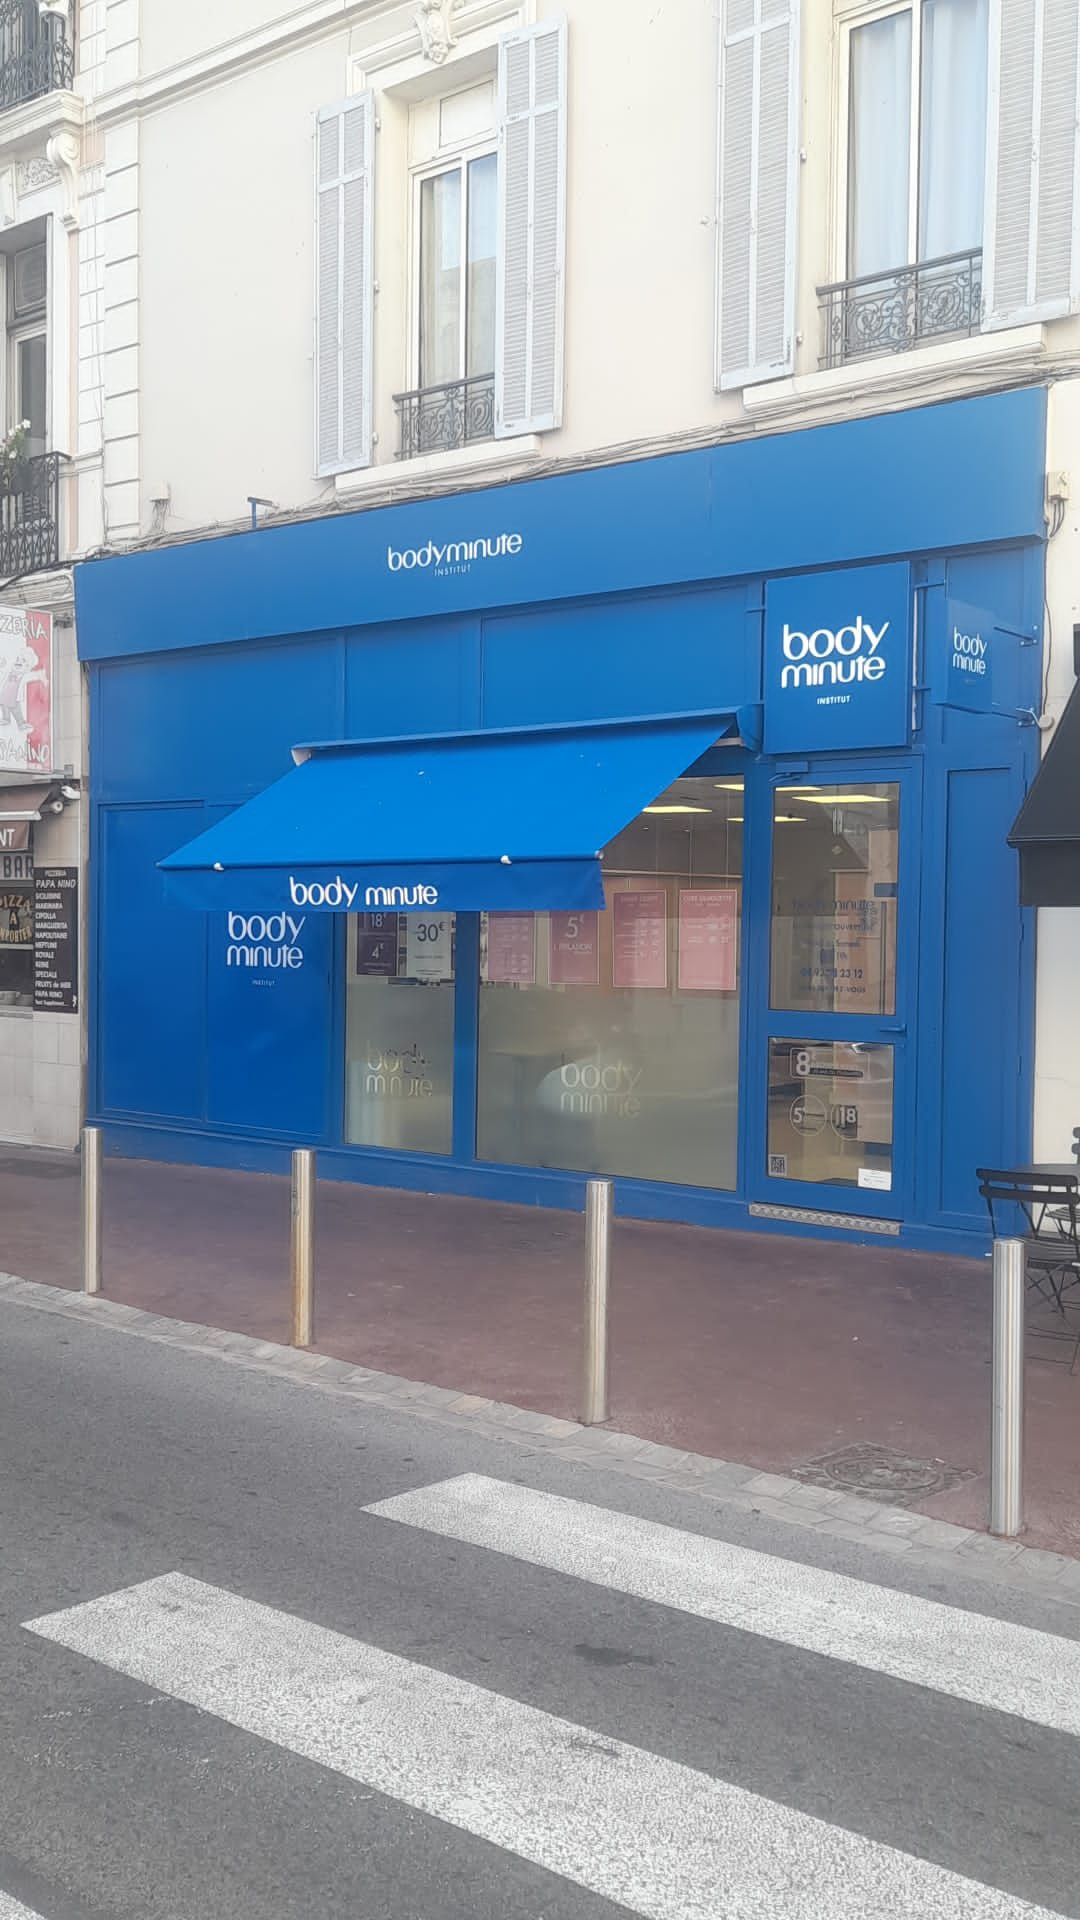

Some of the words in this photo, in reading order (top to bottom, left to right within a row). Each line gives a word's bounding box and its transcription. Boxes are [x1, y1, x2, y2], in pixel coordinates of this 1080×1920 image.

[434, 563, 471, 577] INSTITUT
[783, 615, 890, 661] body
[953, 625, 988, 658] body
[781, 656, 886, 688] minute
[952, 653, 987, 675] minute
[817, 695, 850, 705] INSTITUT
[36, 879, 56, 889] PAPA
[57, 879, 76, 889] NINO
[289, 875, 358, 907] body
[365, 883, 438, 906] minute
[227, 911, 306, 944] body
[226, 944, 304, 969] minute
